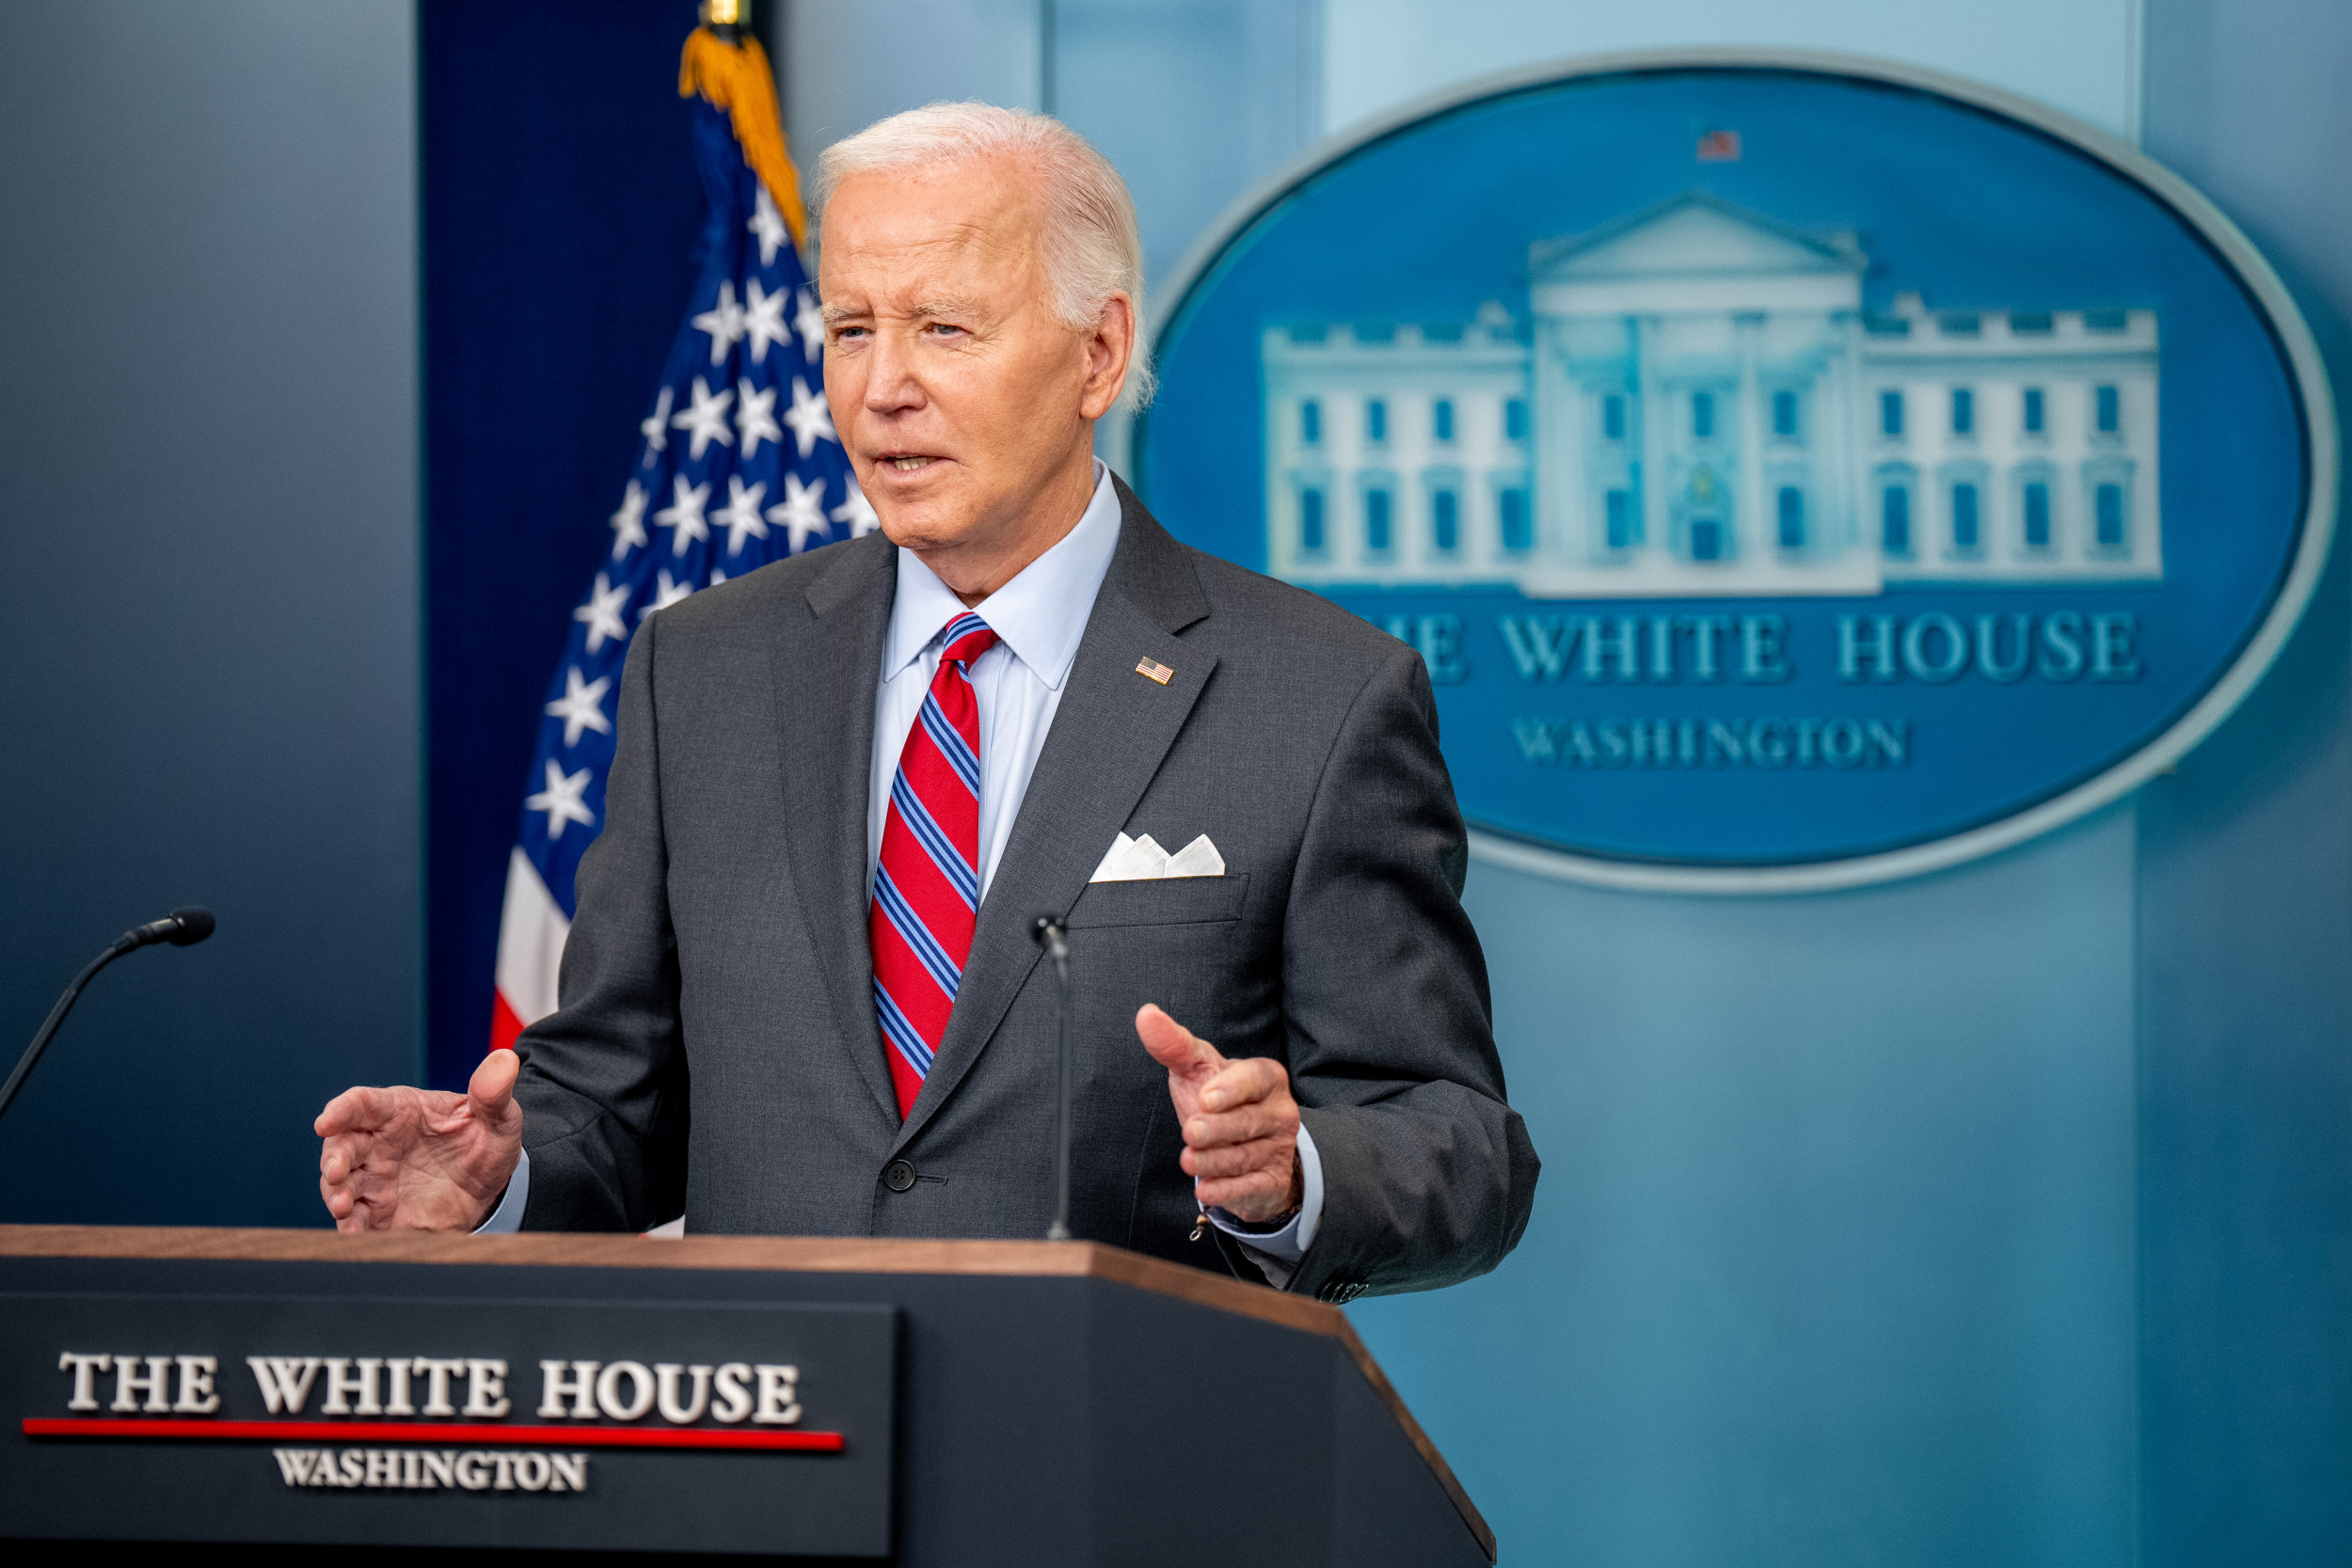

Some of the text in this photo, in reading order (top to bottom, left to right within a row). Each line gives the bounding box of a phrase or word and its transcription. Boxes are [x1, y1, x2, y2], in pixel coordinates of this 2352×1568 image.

[1500, 613, 1791, 683] WHITE
[1836, 613, 2142, 684] HOUSE
[1513, 718, 1909, 767] WASHINGTON
[60, 1353, 802, 1424] THE WHITE HOUSE
[274, 1449, 587, 1493] WASHINGTON
